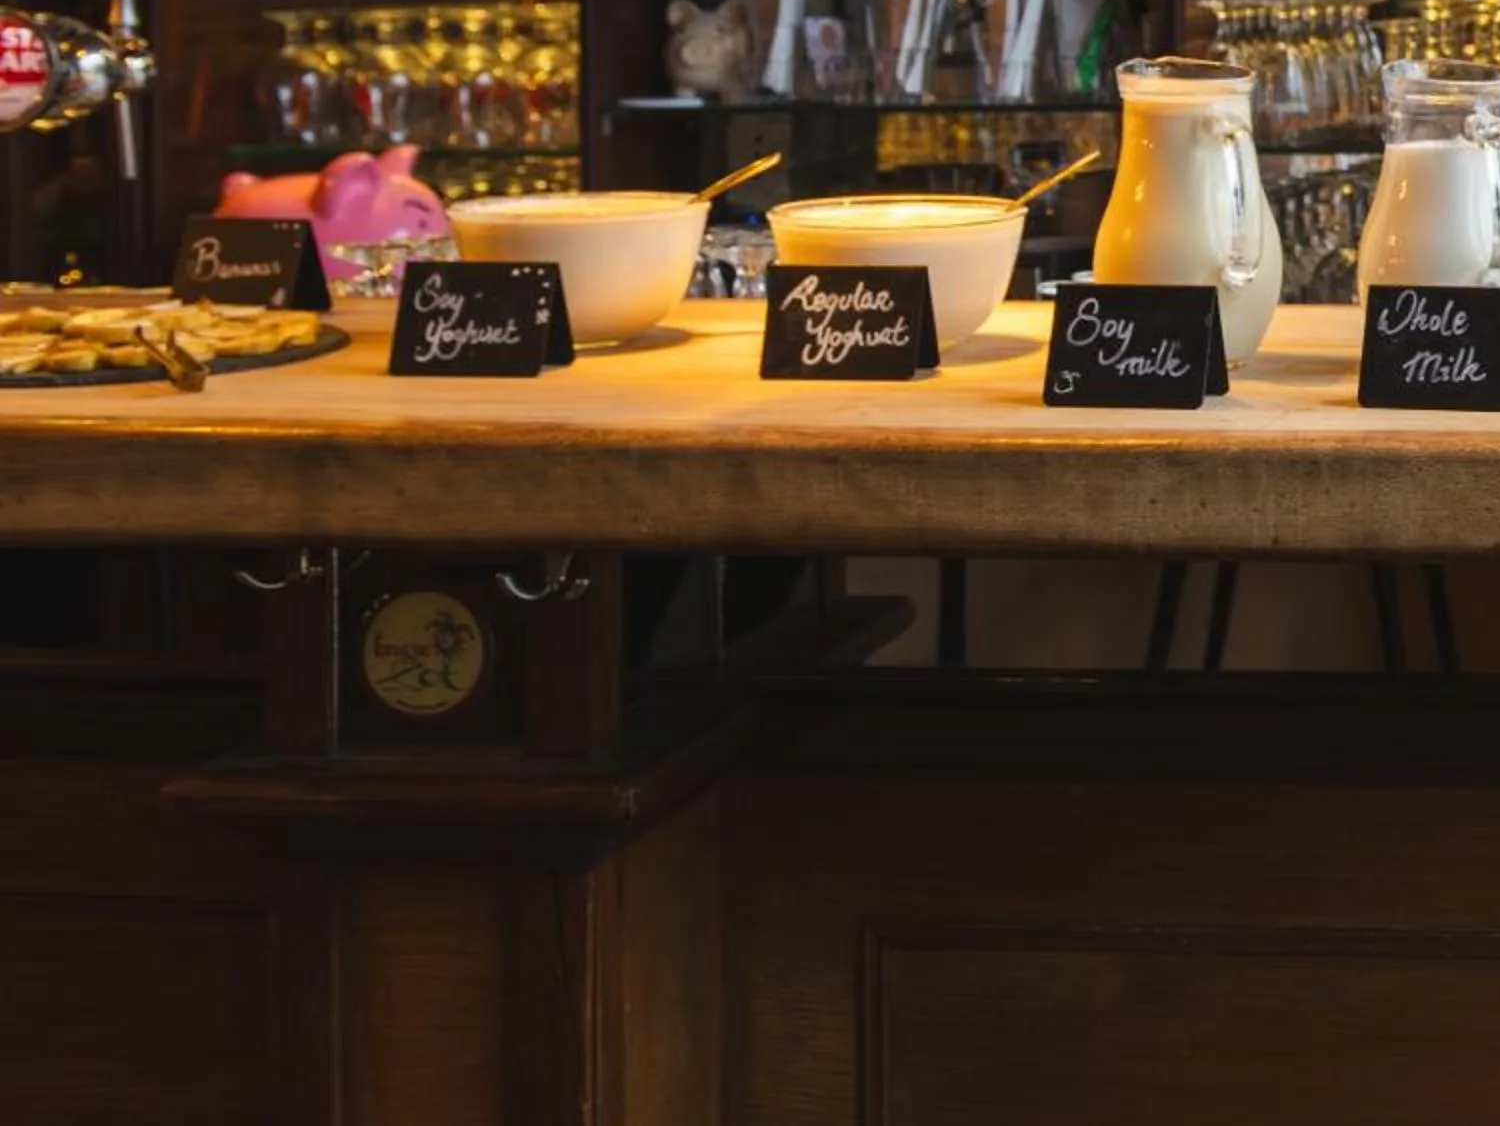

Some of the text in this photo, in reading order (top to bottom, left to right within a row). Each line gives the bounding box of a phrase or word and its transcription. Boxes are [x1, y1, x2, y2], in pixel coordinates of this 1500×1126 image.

[413, 272, 466, 326] Soy
[778, 274, 897, 329] Regular
[801, 315, 911, 366] Yoghurt
[1066, 297, 1136, 367] Soy
